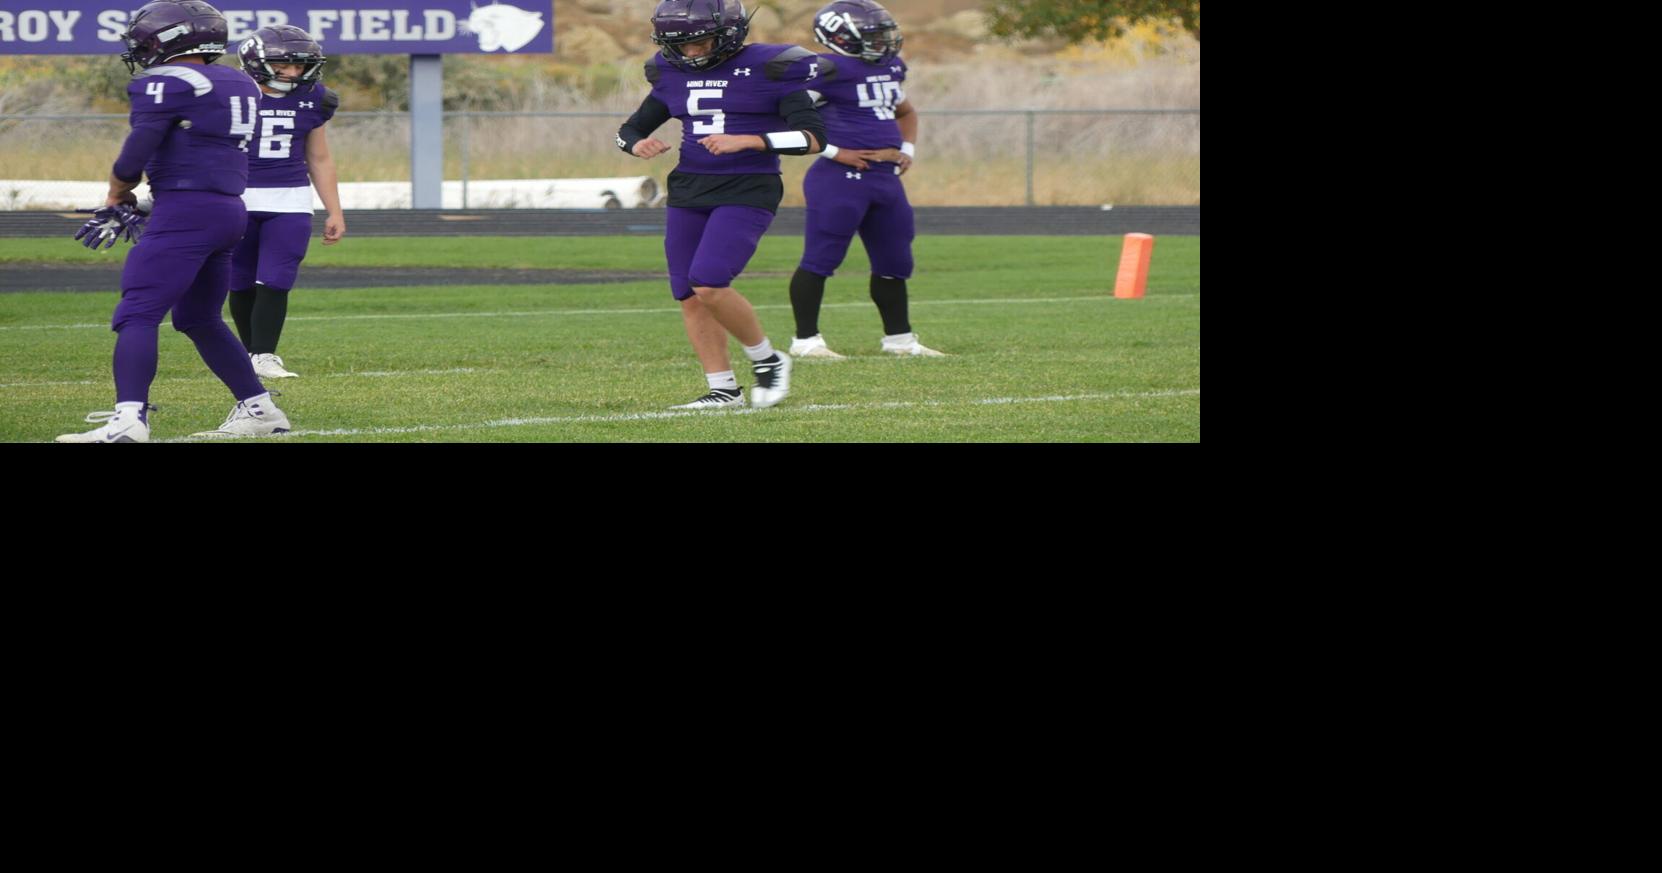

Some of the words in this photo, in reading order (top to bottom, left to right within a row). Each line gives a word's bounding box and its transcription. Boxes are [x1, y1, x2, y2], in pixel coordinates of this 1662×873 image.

[307, 9, 456, 41] FIELD
[819, 11, 844, 32] 40
[146, 82, 165, 104] 4
[705, 80, 728, 88] RIVER
[856, 81, 906, 120] 40
[229, 95, 257, 153] 4
[686, 88, 726, 134] 5
[258, 117, 295, 158] 6
